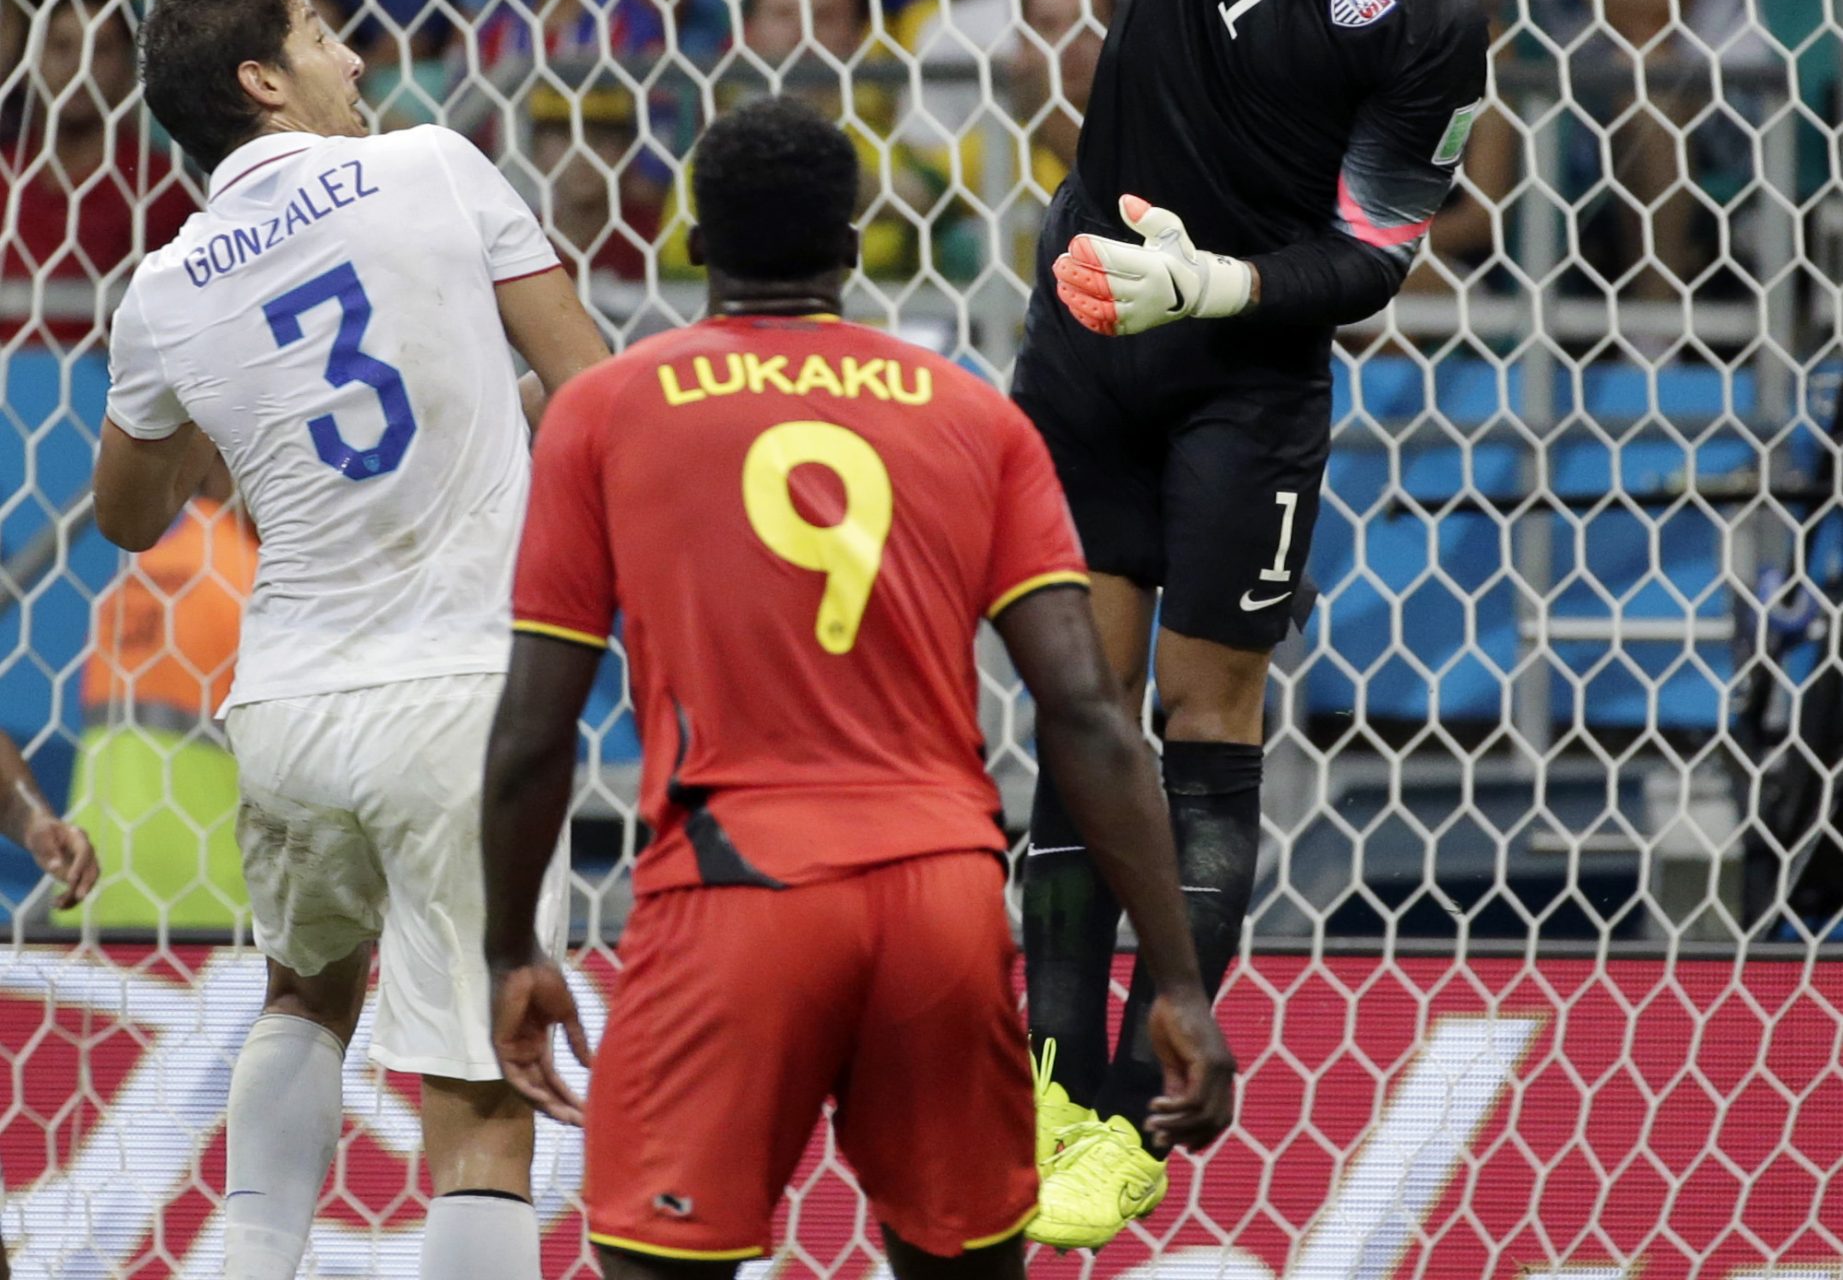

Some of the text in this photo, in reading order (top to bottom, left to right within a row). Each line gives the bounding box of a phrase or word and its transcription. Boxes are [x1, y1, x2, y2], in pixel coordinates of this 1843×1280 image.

[183, 159, 380, 288] GONZALEZ
[261, 260, 417, 482] 3
[657, 351, 933, 407] LUKAKU
[742, 419, 894, 656] 9
[1258, 491, 1299, 582] 1
